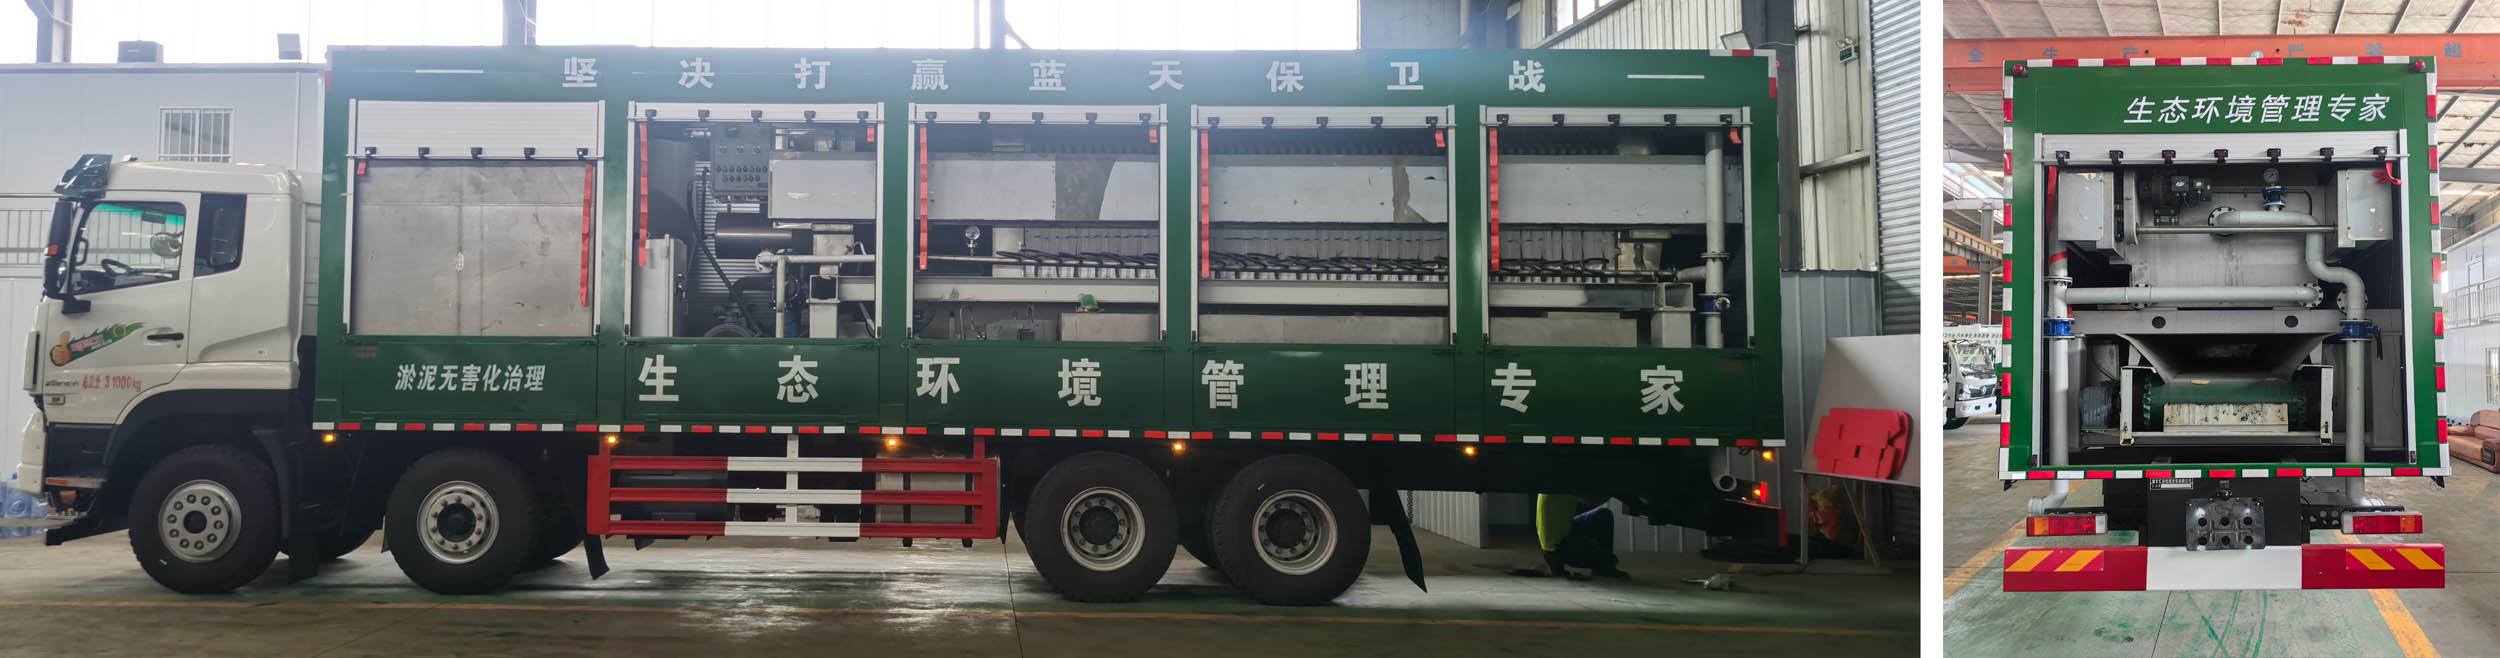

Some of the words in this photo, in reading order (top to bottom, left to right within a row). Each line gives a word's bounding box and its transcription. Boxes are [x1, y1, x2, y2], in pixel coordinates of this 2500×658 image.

[562, 56, 1546, 92] 坚决打赢蓝天保卫战
[2123, 93, 2391, 124] 生态环境管理专家
[395, 364, 546, 392] 淤泥无害化治理
[638, 354, 1685, 415] 生态环境管理专家
